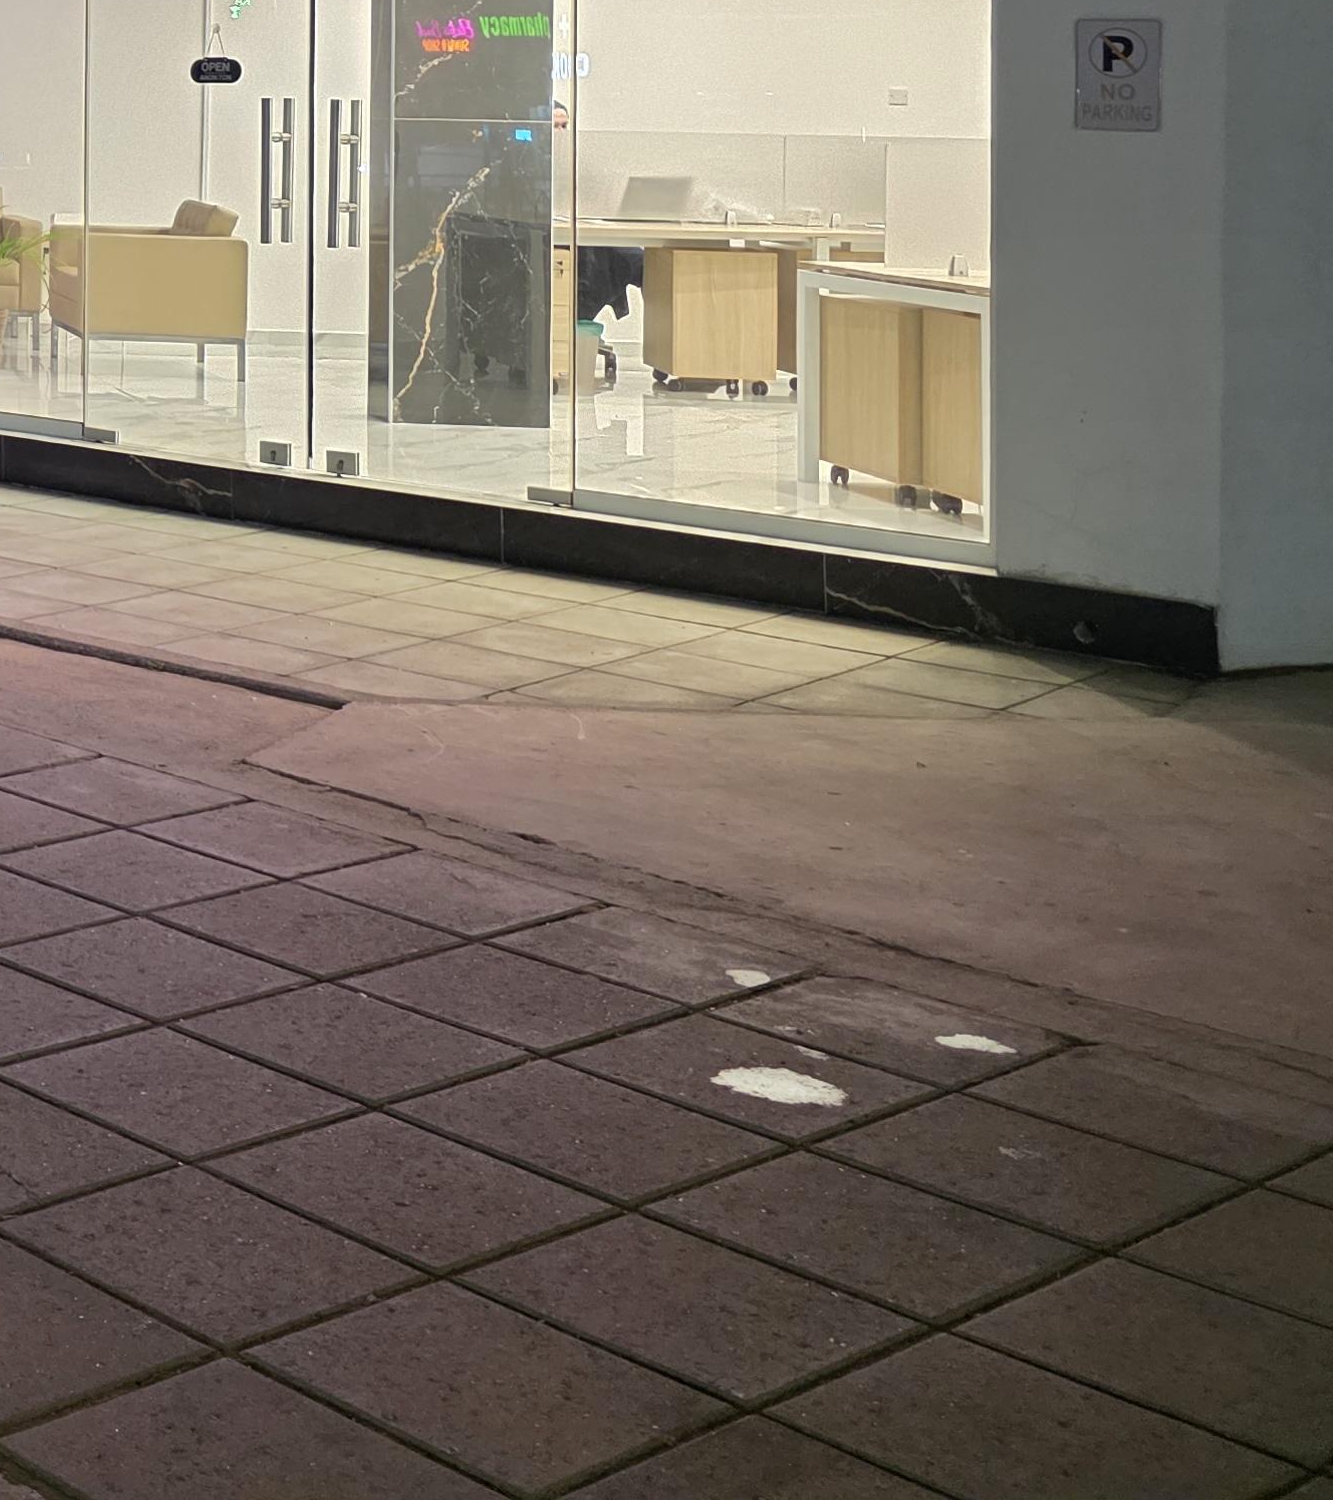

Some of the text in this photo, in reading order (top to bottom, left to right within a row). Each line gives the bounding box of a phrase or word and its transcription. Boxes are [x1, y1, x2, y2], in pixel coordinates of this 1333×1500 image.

[201, 61, 231, 72] OPEN
[1100, 83, 1135, 100] NO
[1081, 103, 1153, 122] PARKING
